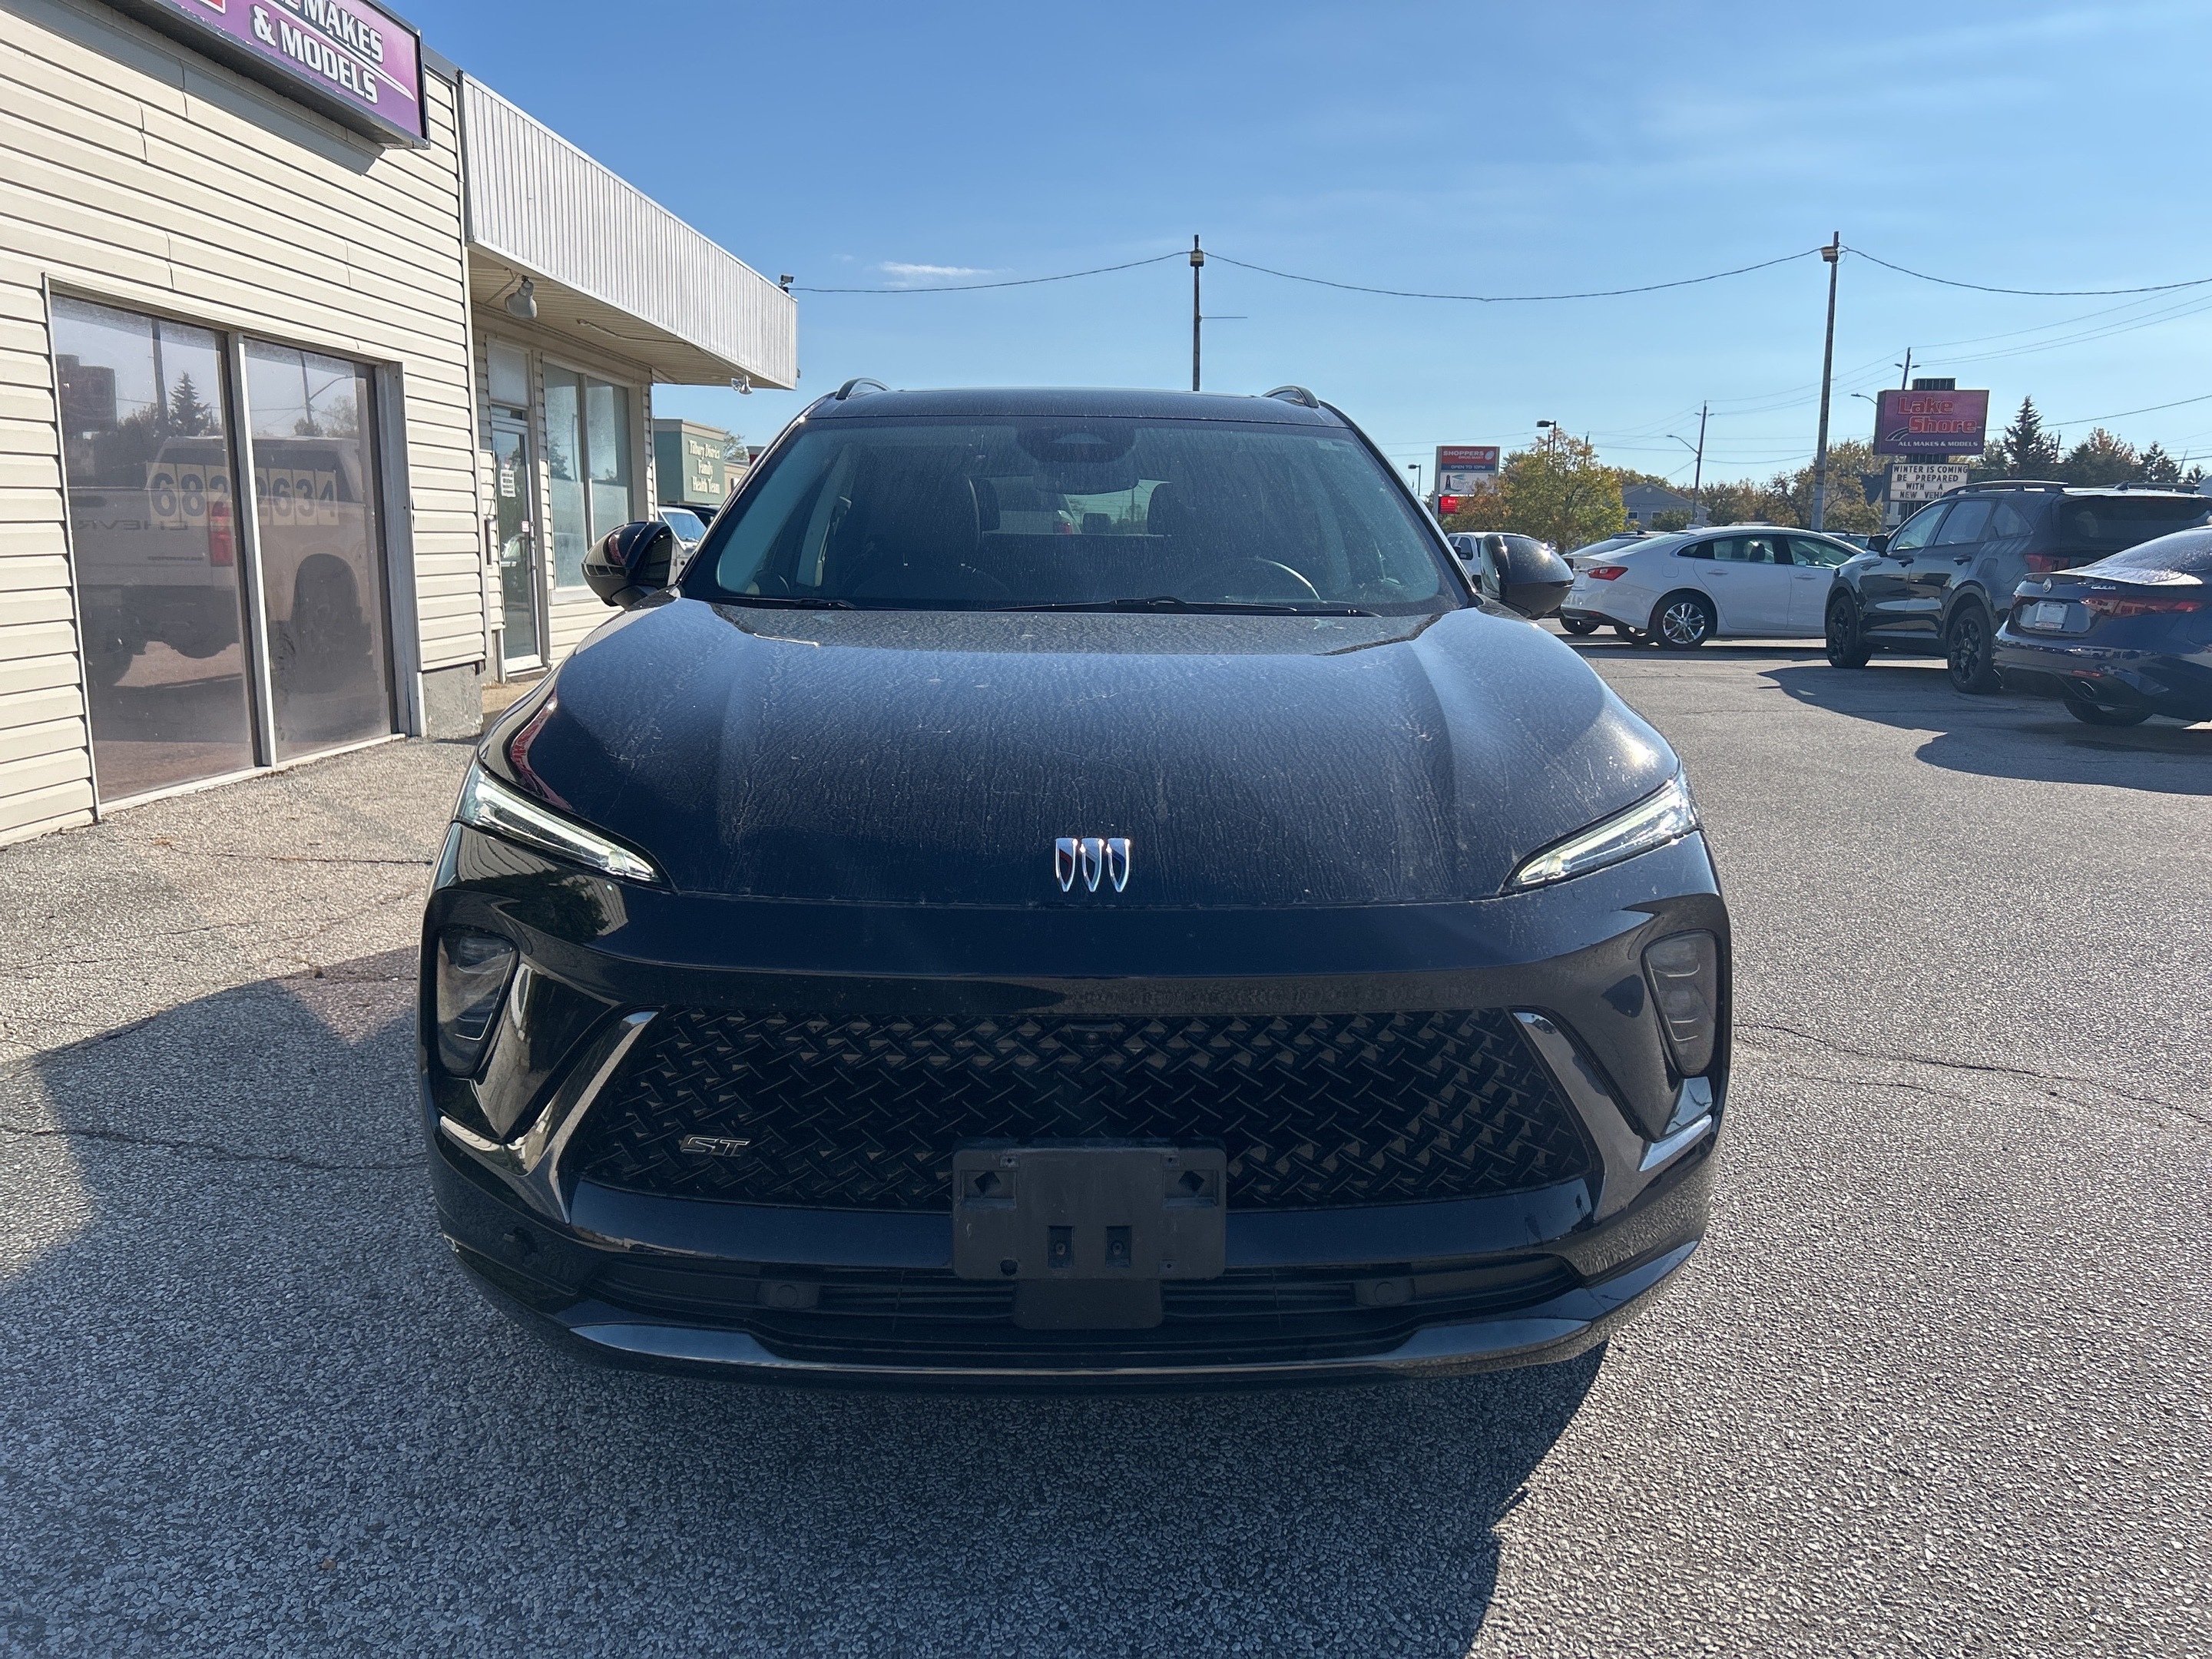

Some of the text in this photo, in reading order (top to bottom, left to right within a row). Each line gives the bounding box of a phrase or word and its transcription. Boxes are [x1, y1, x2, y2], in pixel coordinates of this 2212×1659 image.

[304, 0, 383, 64] MAKES
[253, 5, 378, 104] & MODELS
[1898, 396, 1955, 415] Lake
[1909, 416, 1977, 433] Shore
[689, 440, 720, 460] Tilbury District
[697, 460, 714, 480] Family
[1893, 465, 1923, 473] WINTER
[1937, 465, 1969, 474] COMING
[691, 475, 720, 495] Health Team
[680, 1136, 751, 1157] ST
